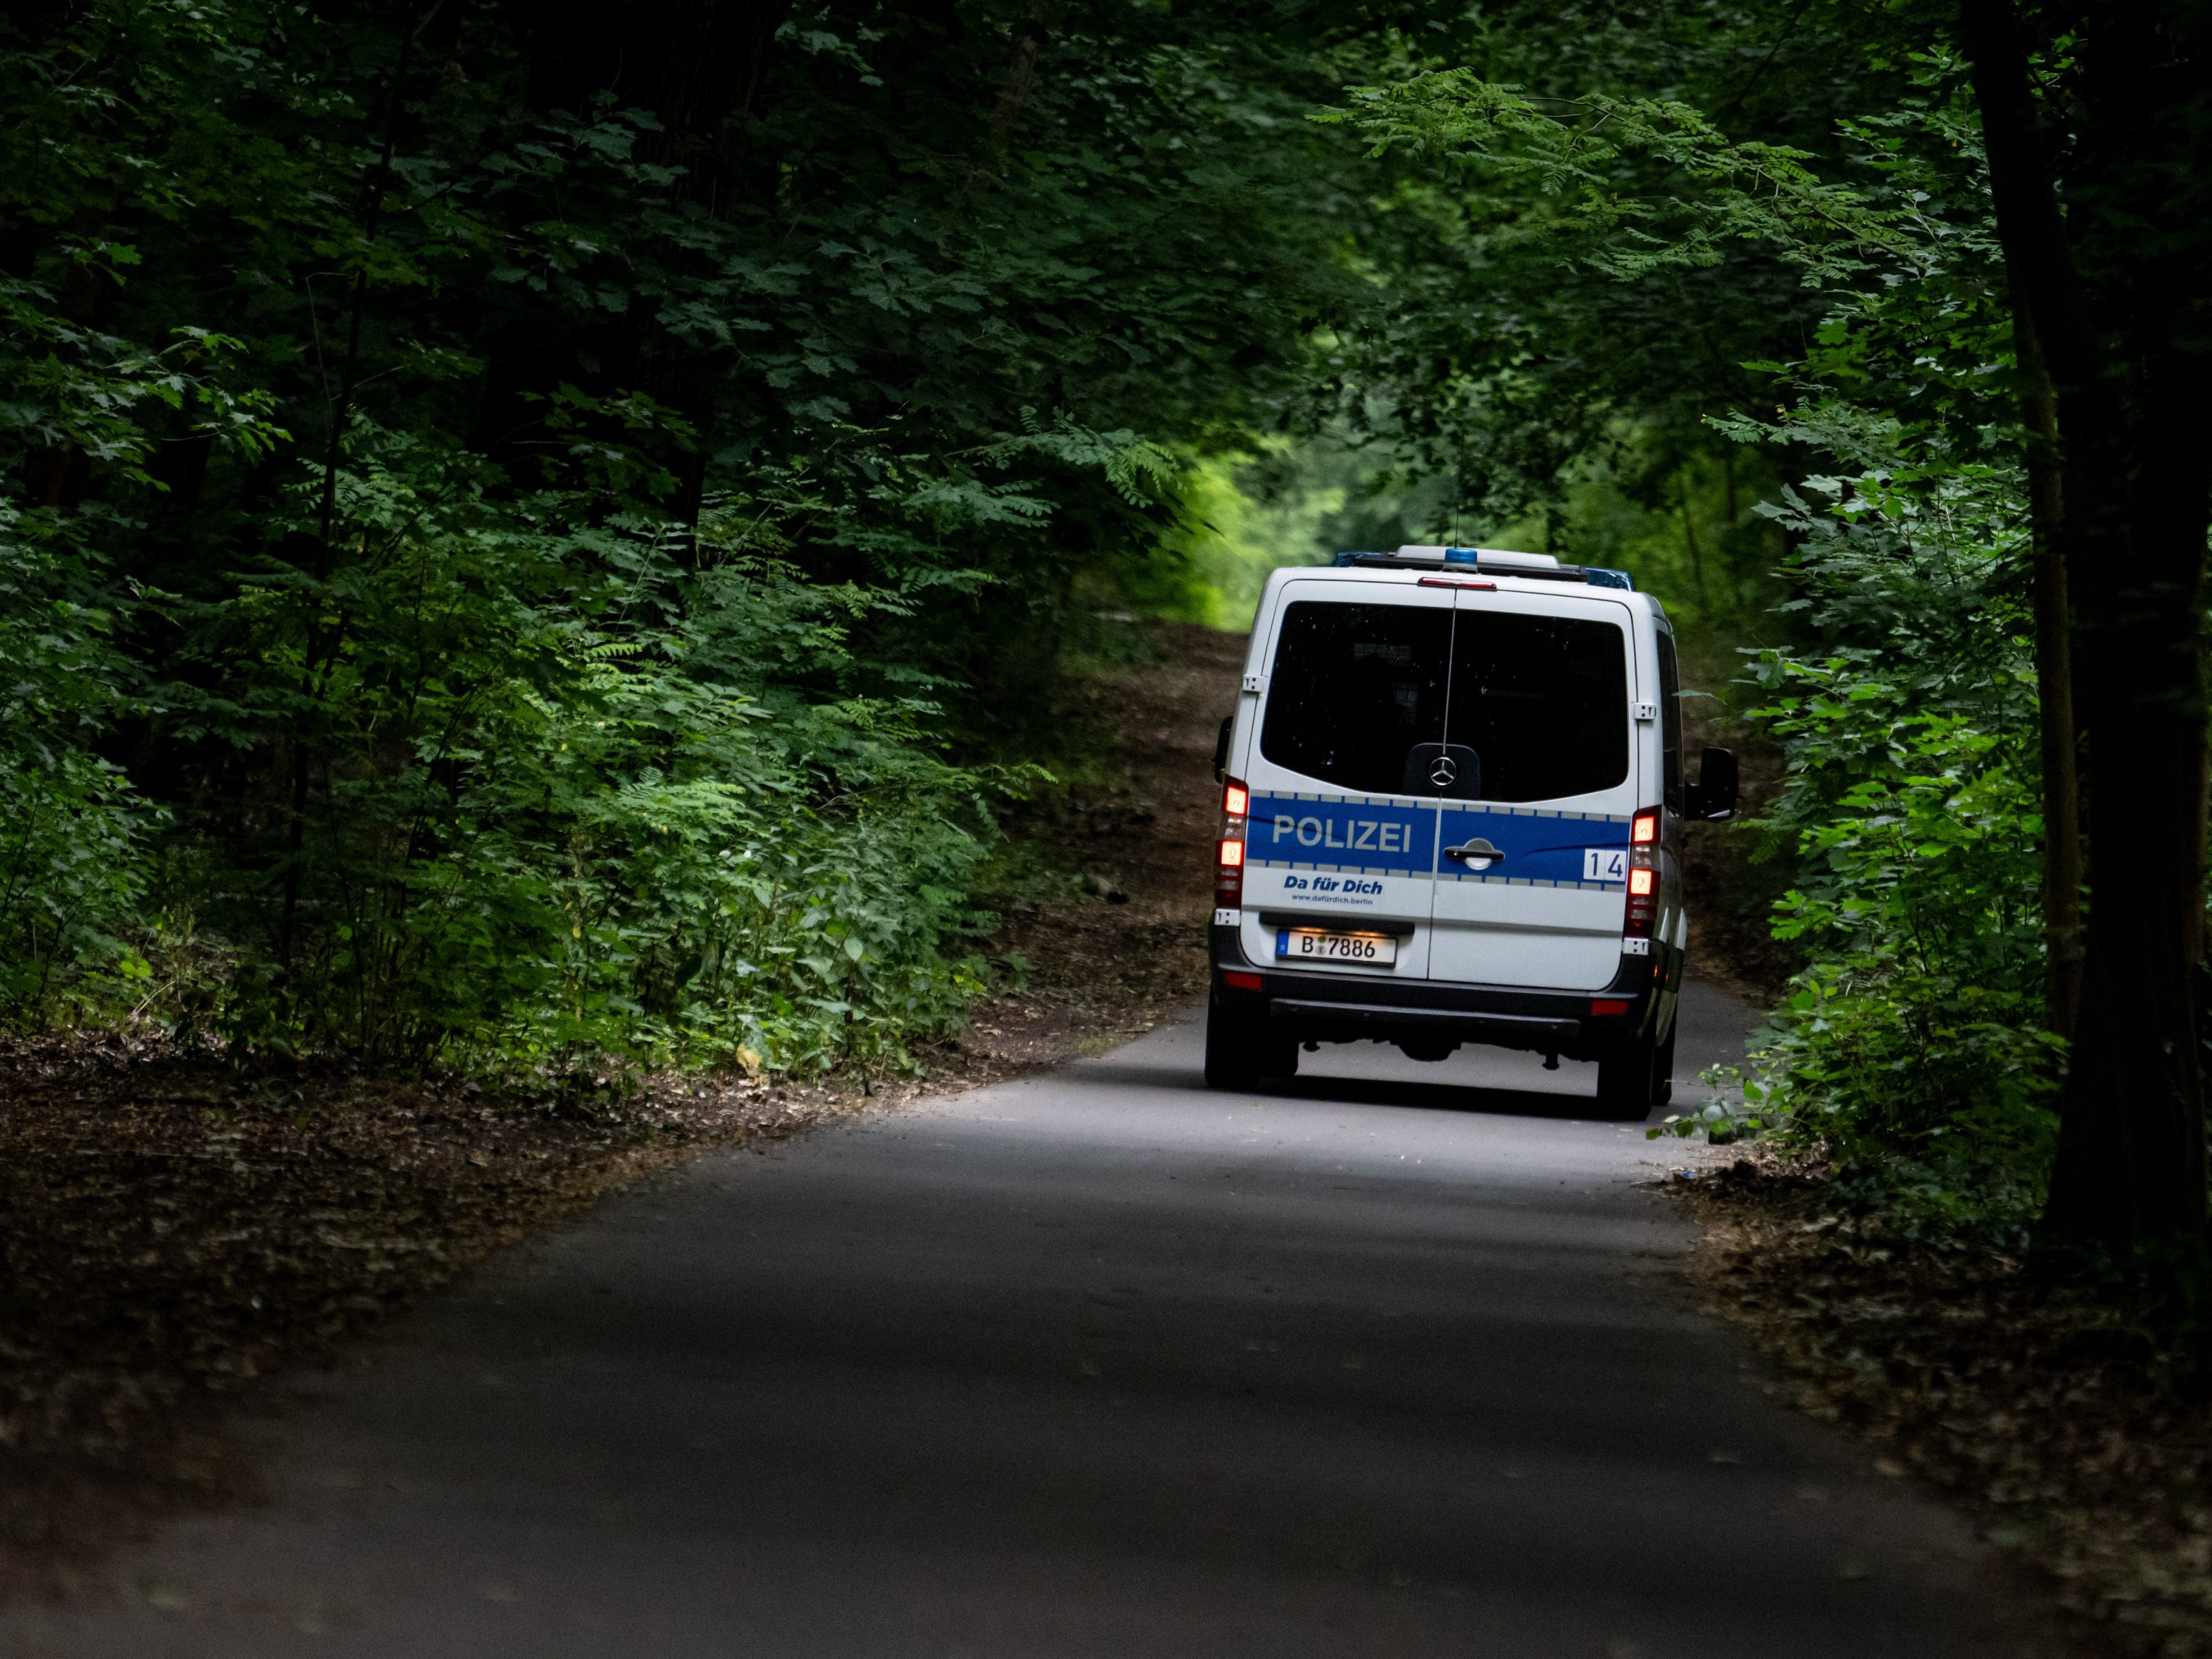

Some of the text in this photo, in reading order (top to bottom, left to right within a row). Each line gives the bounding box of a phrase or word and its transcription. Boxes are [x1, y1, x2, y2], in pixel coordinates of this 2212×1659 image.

[1273, 815, 1411, 853] POLIZEI
[1591, 853, 1623, 877] 14
[1284, 876, 1383, 895] Da für Dich
[1292, 894, 1373, 906] www.dafürdich.berlin
[1302, 936, 1375, 958] B 7886
